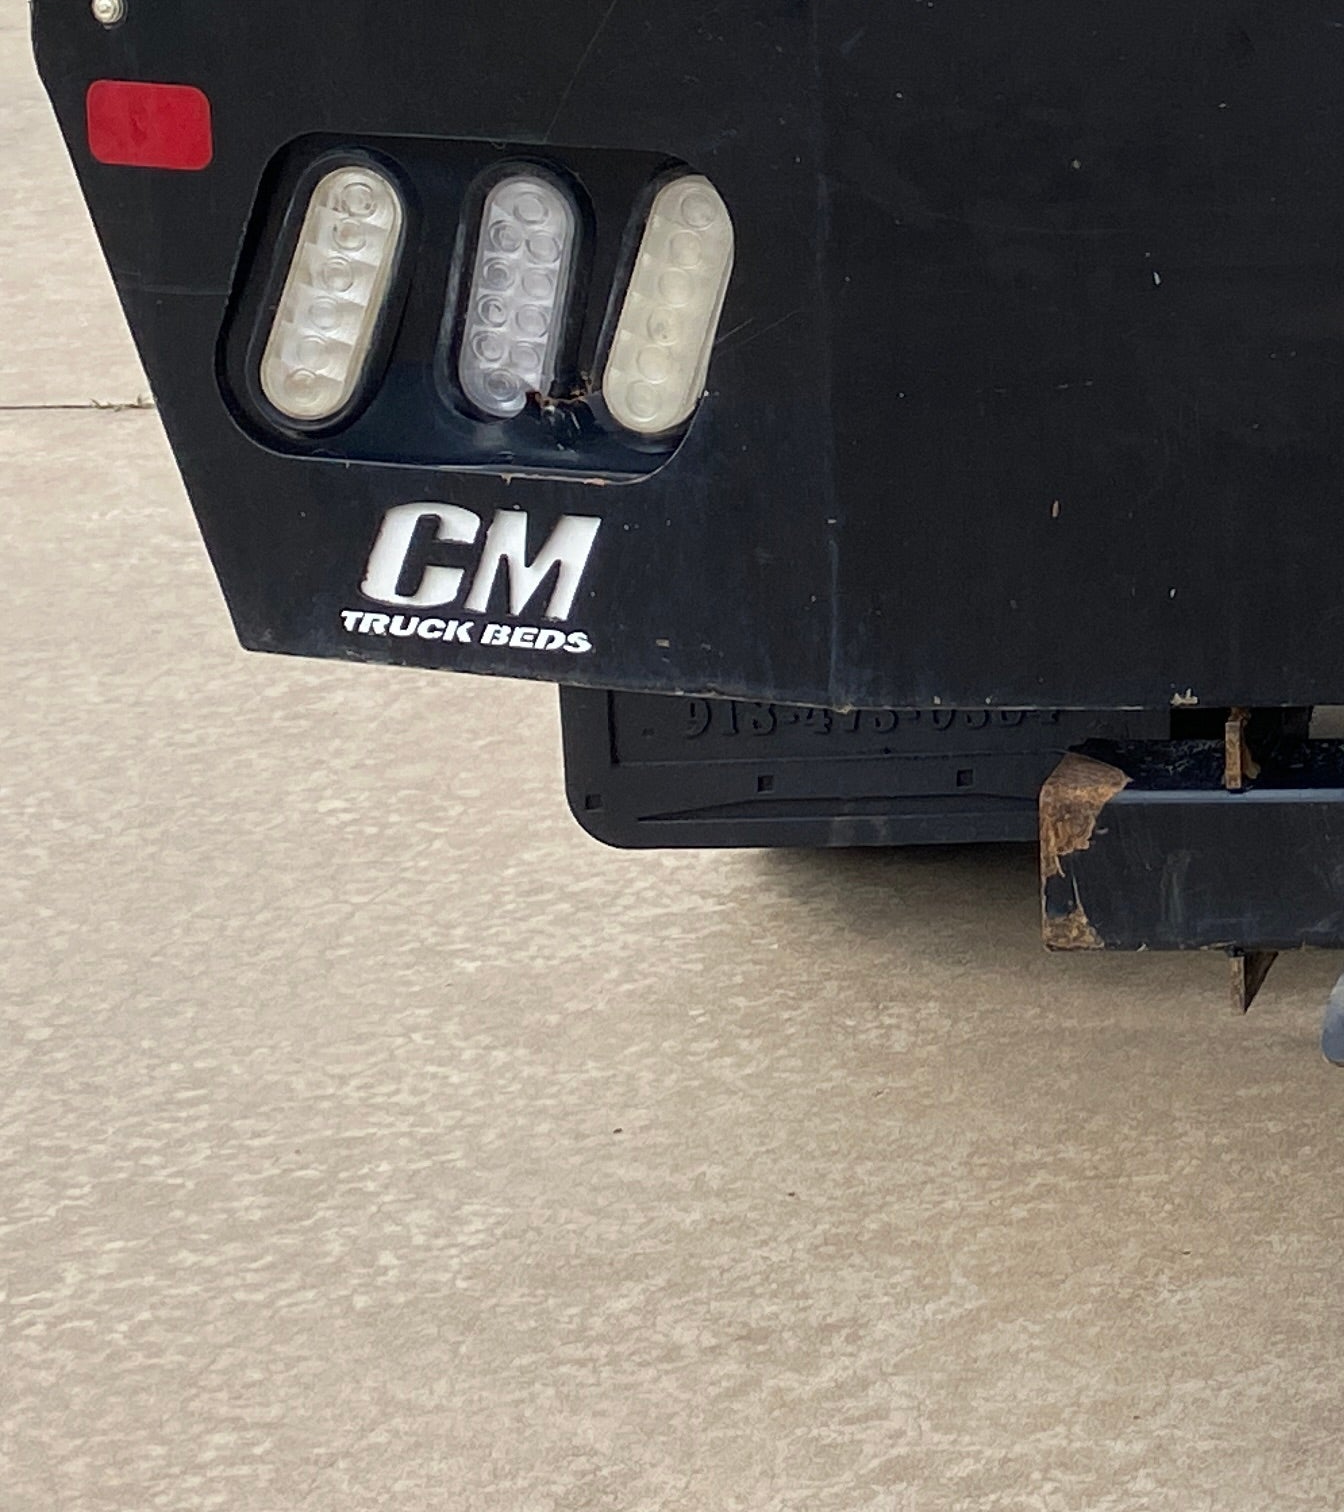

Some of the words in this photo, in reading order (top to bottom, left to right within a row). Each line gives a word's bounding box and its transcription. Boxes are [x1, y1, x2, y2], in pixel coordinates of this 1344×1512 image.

[360, 501, 602, 622] CM
[340, 610, 476, 643] TRUCK
[480, 623, 593, 654] BEDS
